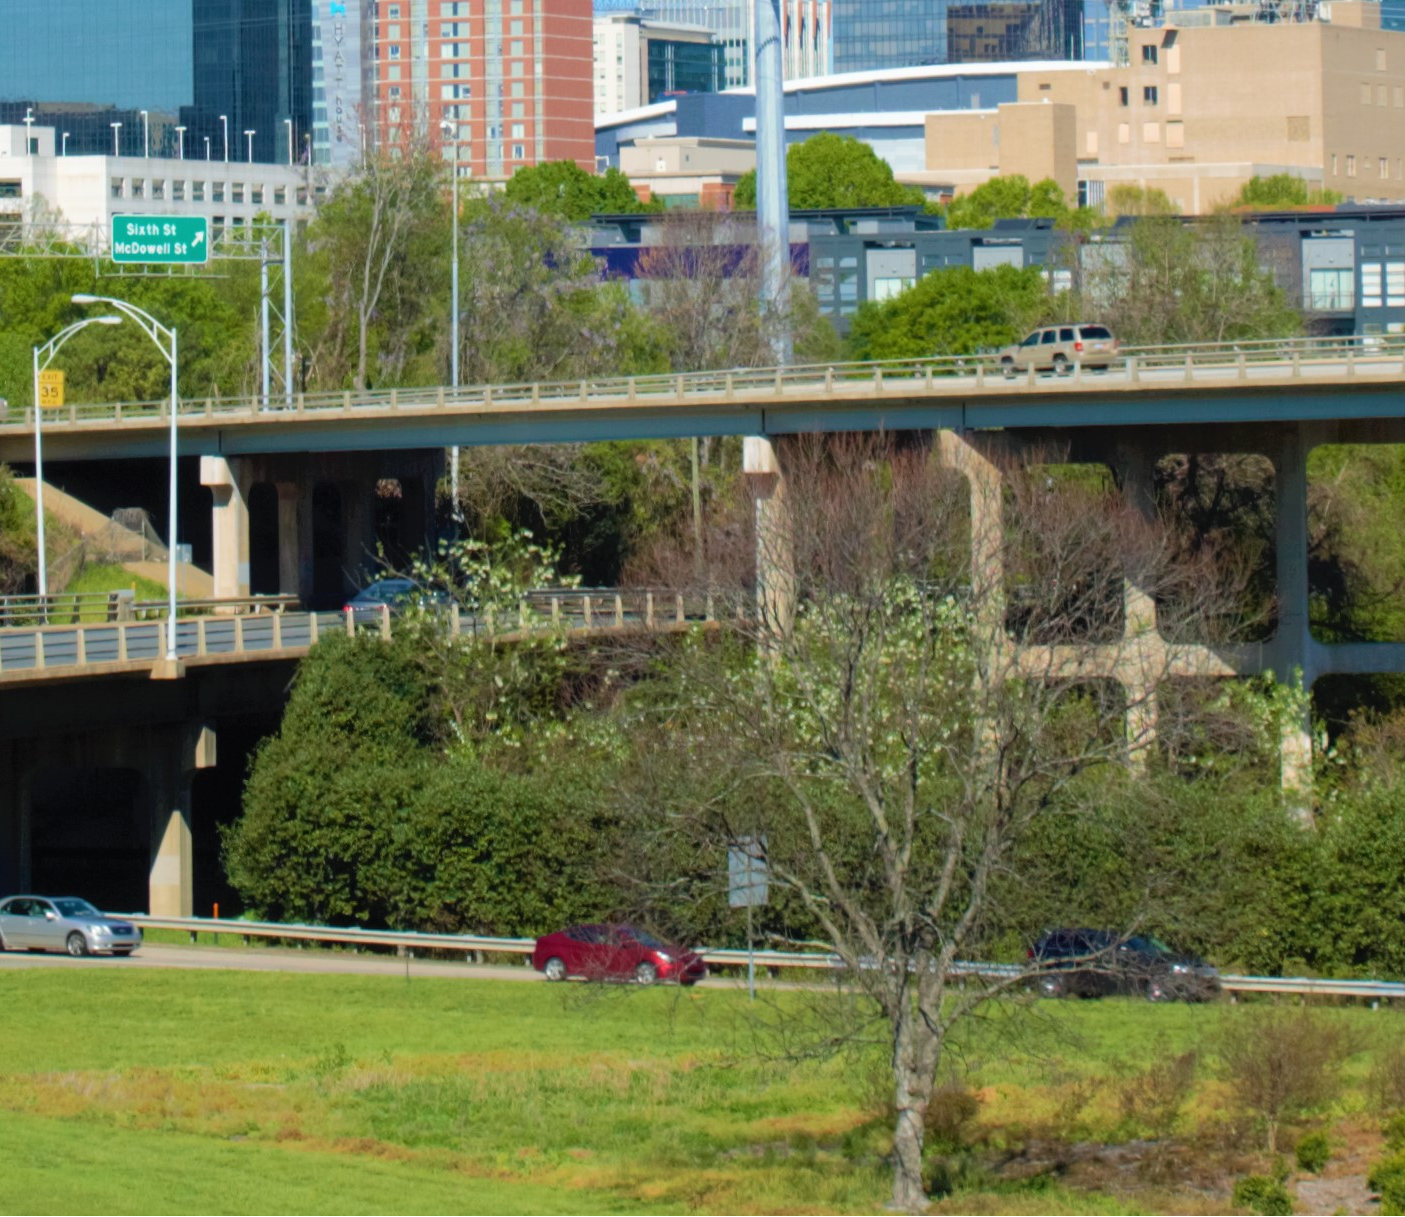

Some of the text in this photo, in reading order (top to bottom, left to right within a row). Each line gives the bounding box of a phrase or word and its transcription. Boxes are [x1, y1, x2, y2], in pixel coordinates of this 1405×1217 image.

[334, 23, 344, 143] HYATT house
[127, 223, 177, 236] Sixth St
[115, 241, 188, 255] McDowell St
[41, 386, 59, 398] 35
